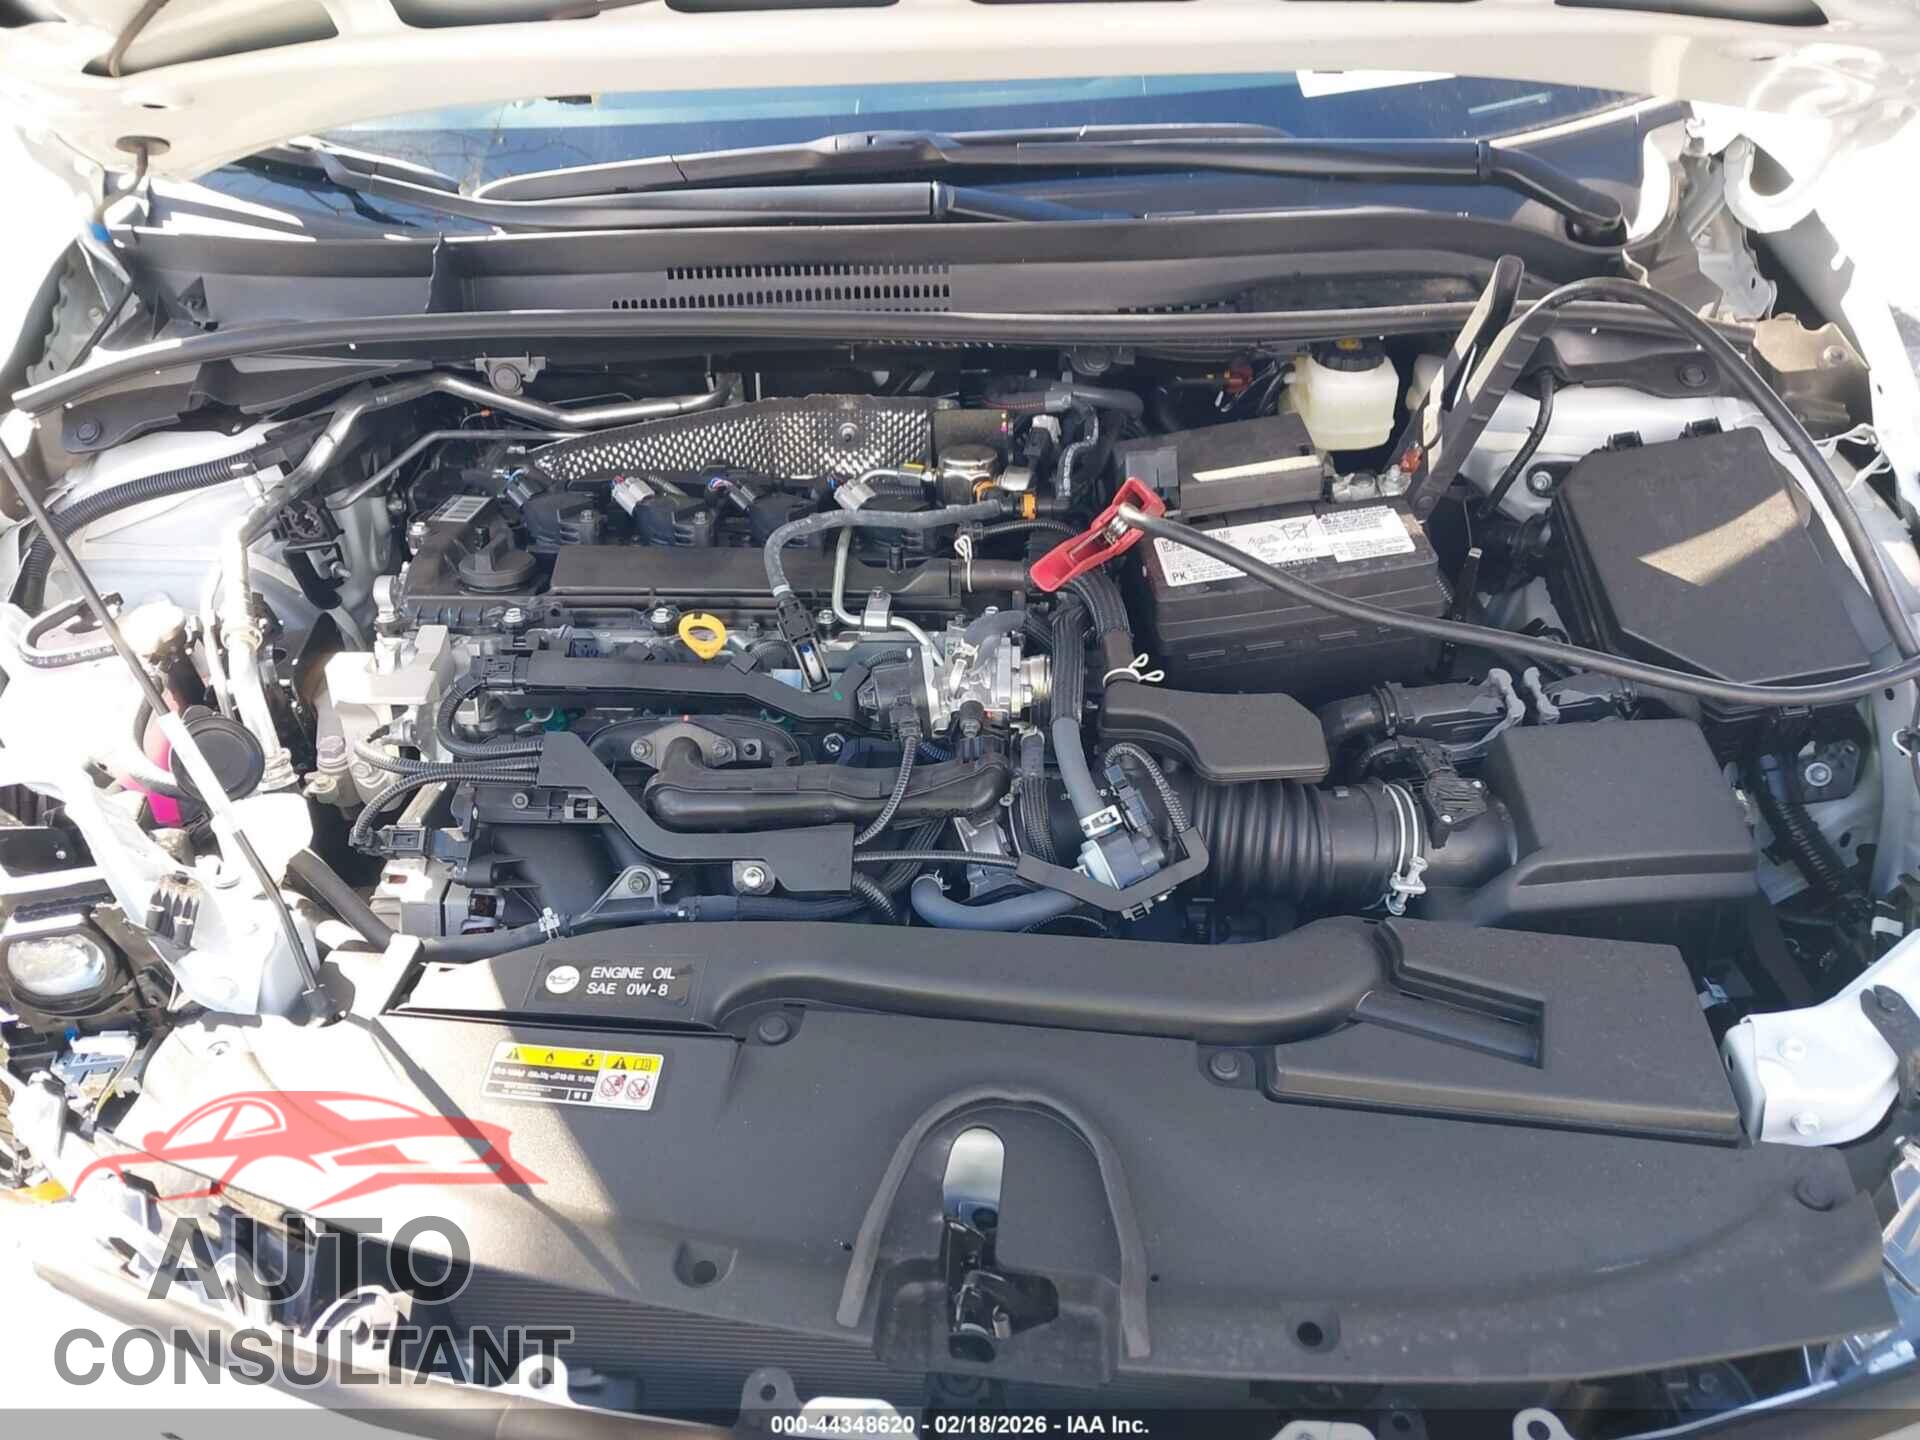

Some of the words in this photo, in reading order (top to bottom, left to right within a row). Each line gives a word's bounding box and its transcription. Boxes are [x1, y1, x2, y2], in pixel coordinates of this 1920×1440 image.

[1172, 571, 1187, 582] PK
[590, 966, 644, 980] ENGINE
[652, 967, 676, 980] OIL
[586, 982, 617, 995] SAE
[626, 983, 669, 997] 0W-8
